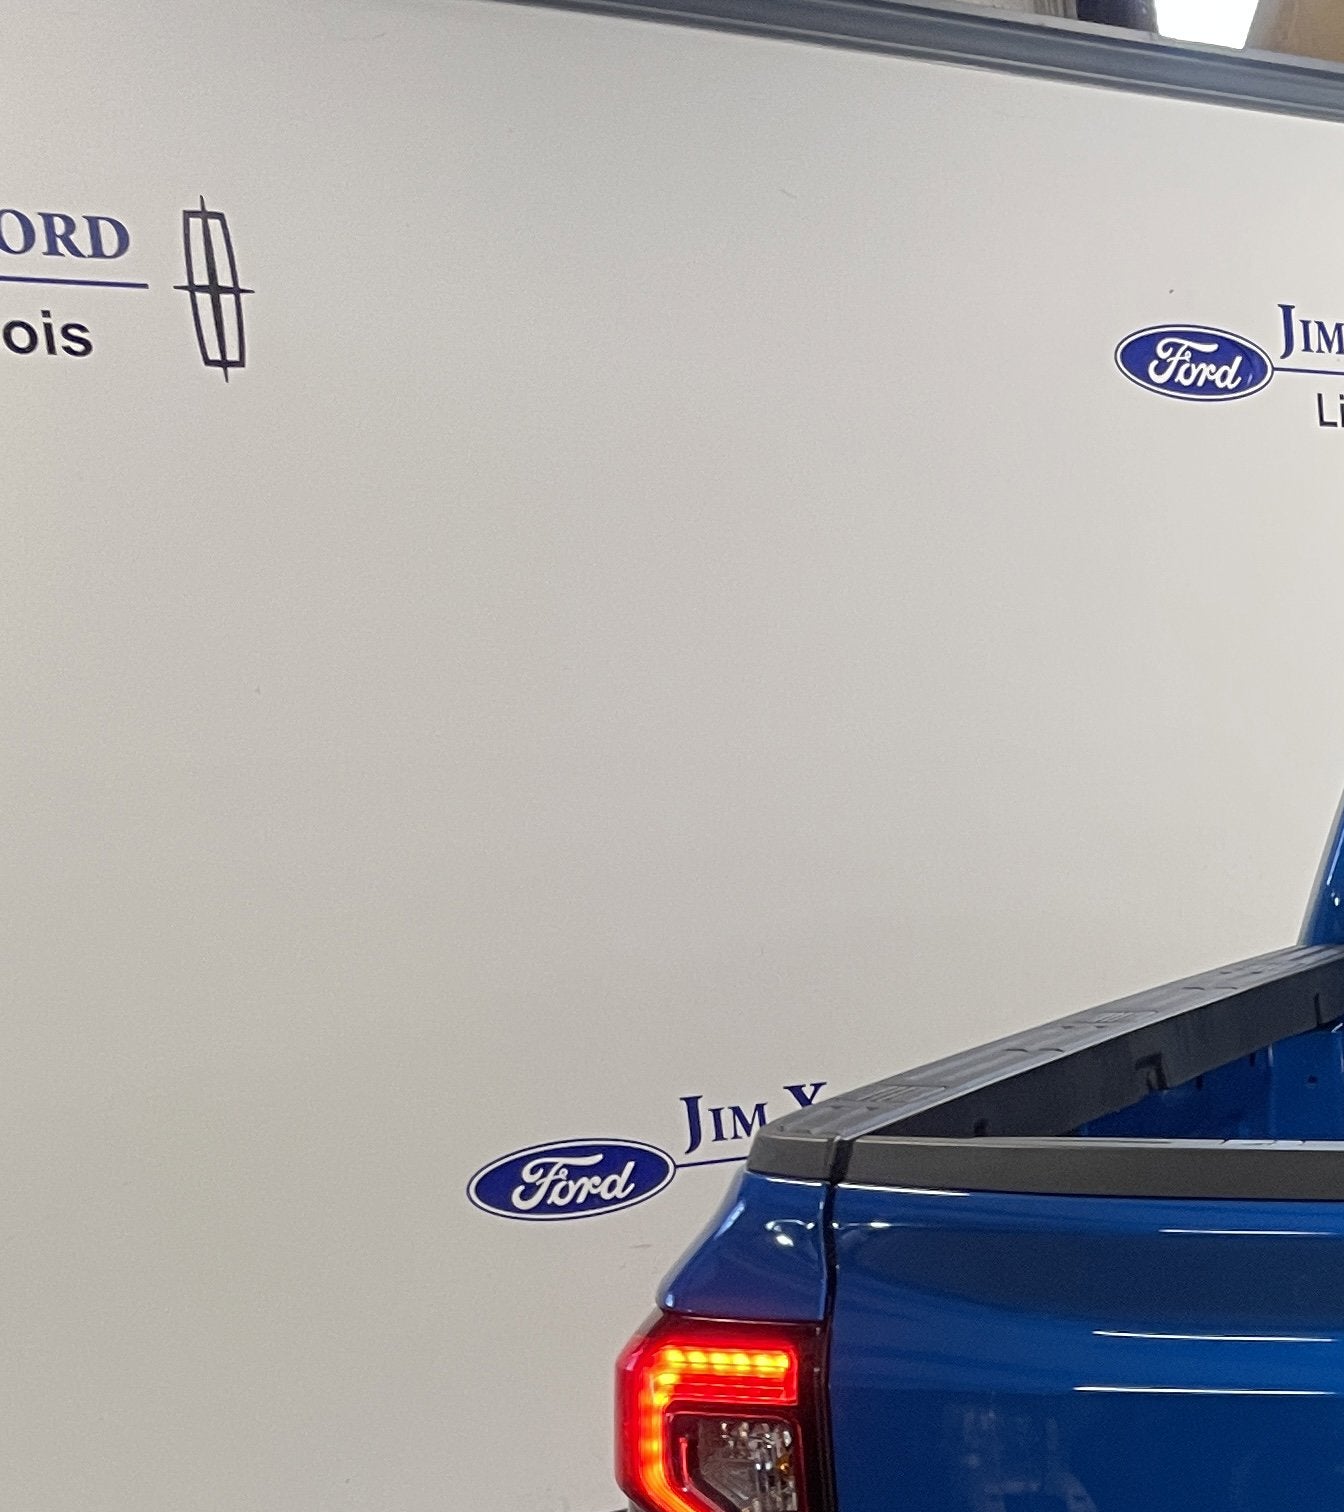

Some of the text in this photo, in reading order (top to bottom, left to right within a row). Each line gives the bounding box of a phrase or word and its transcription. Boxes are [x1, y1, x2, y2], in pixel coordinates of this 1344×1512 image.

[1148, 336, 1242, 390] Ford
[679, 1095, 768, 1155] JIM
[511, 1153, 636, 1211] Ford
